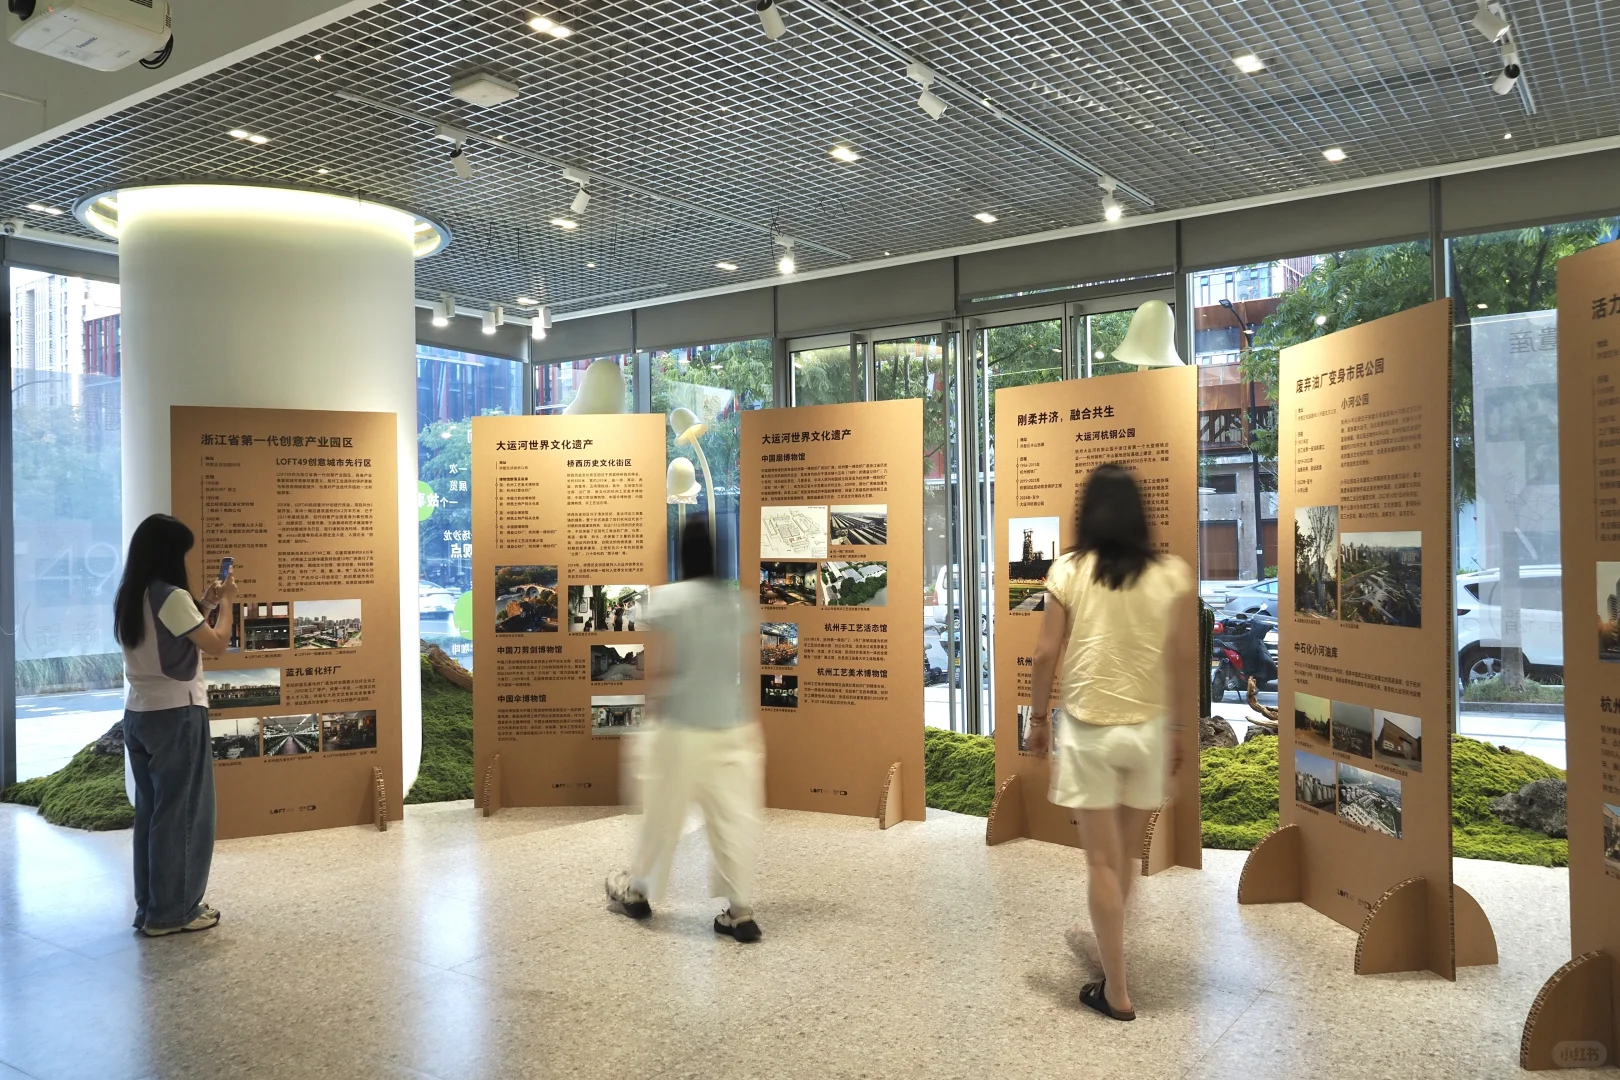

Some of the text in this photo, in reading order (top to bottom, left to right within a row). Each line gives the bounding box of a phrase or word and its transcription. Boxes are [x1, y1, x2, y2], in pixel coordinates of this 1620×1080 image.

[1295, 357, 1385, 394] 废弃油厂变身市民公园
[1340, 393, 1370, 410] 小河公园
[1017, 405, 1115, 427] 刚柔并济，融合共生
[201, 433, 353, 448] 浙江省第一代创意产业园区
[761, 429, 852, 445] 大运河世界文化遗产
[1075, 428, 1136, 442] 大运河杭钢公园
[496, 438, 594, 451] 大运河世界文化遗产
[276, 457, 372, 468] LOFT49创意城市先行区
[566, 459, 633, 468] 桥西历史文化街区
[761, 453, 806, 463] 中国扇博物馆
[824, 623, 888, 633] 杭州手工艺活态馆
[497, 645, 563, 655] 中国刀剪剑博物馆
[1294, 641, 1338, 659] 中石化小河油库
[285, 665, 341, 677] 蓝孔雀化纤厂
[817, 668, 888, 678] 杭州工艺美术博物馆
[497, 694, 547, 703] 中国伞博物馆
